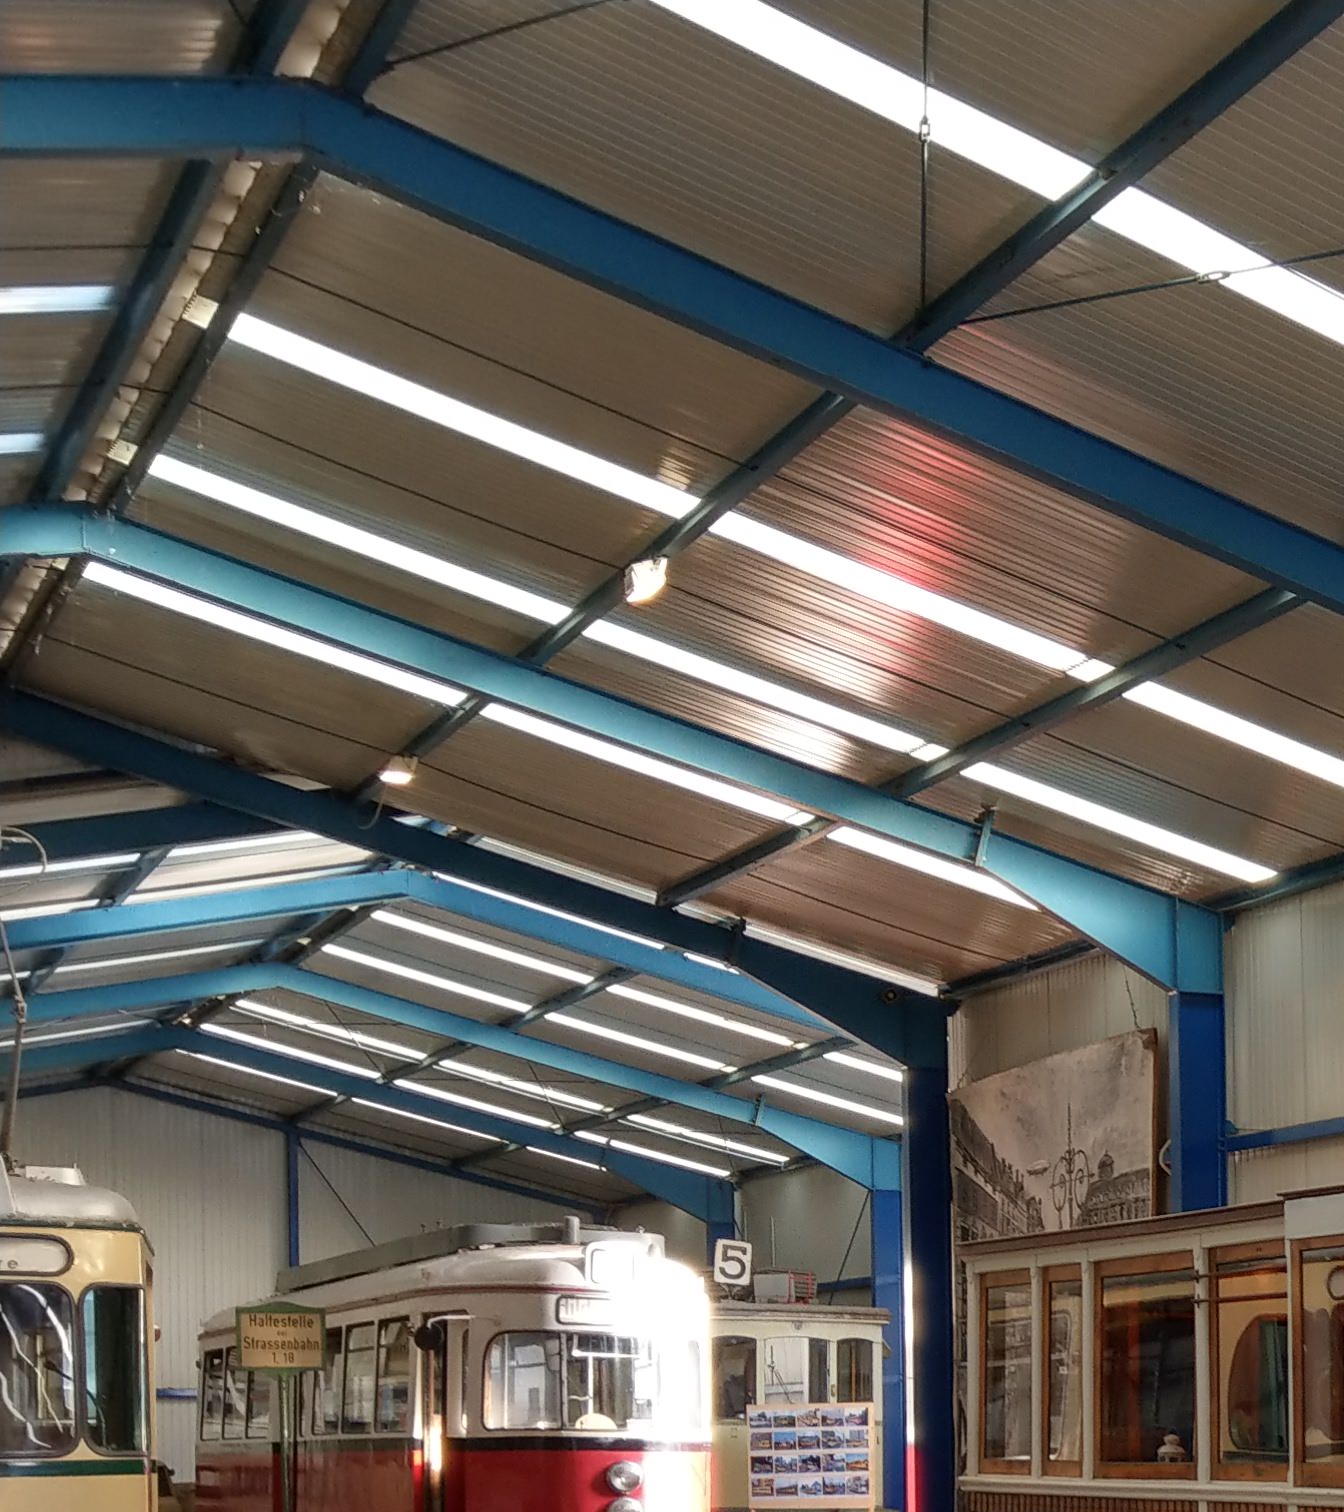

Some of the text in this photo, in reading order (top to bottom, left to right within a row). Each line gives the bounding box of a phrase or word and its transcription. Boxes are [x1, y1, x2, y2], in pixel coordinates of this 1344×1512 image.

[718, 1244, 748, 1280] 5
[248, 1313, 314, 1329] Haltestelle
[243, 1336, 320, 1351] Strassenbahn
